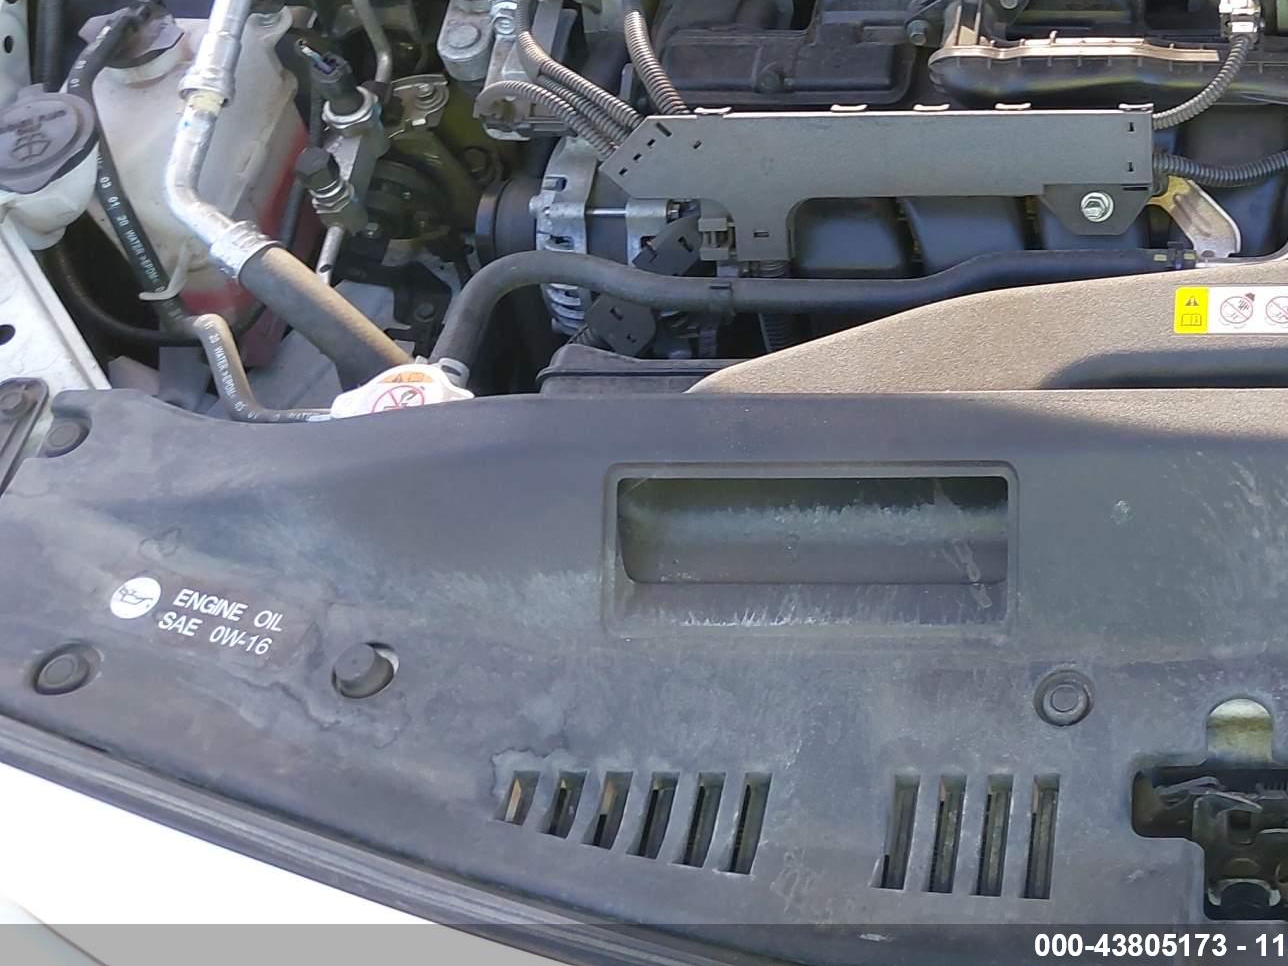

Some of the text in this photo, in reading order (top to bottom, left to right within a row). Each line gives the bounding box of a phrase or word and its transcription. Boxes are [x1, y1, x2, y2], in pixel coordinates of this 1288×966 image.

[126, 229, 145, 256] WATER
[214, 345, 229, 372] WATER
[173, 588, 284, 631] ENGINE OIL
[158, 611, 273, 655] SAE 0W-16
